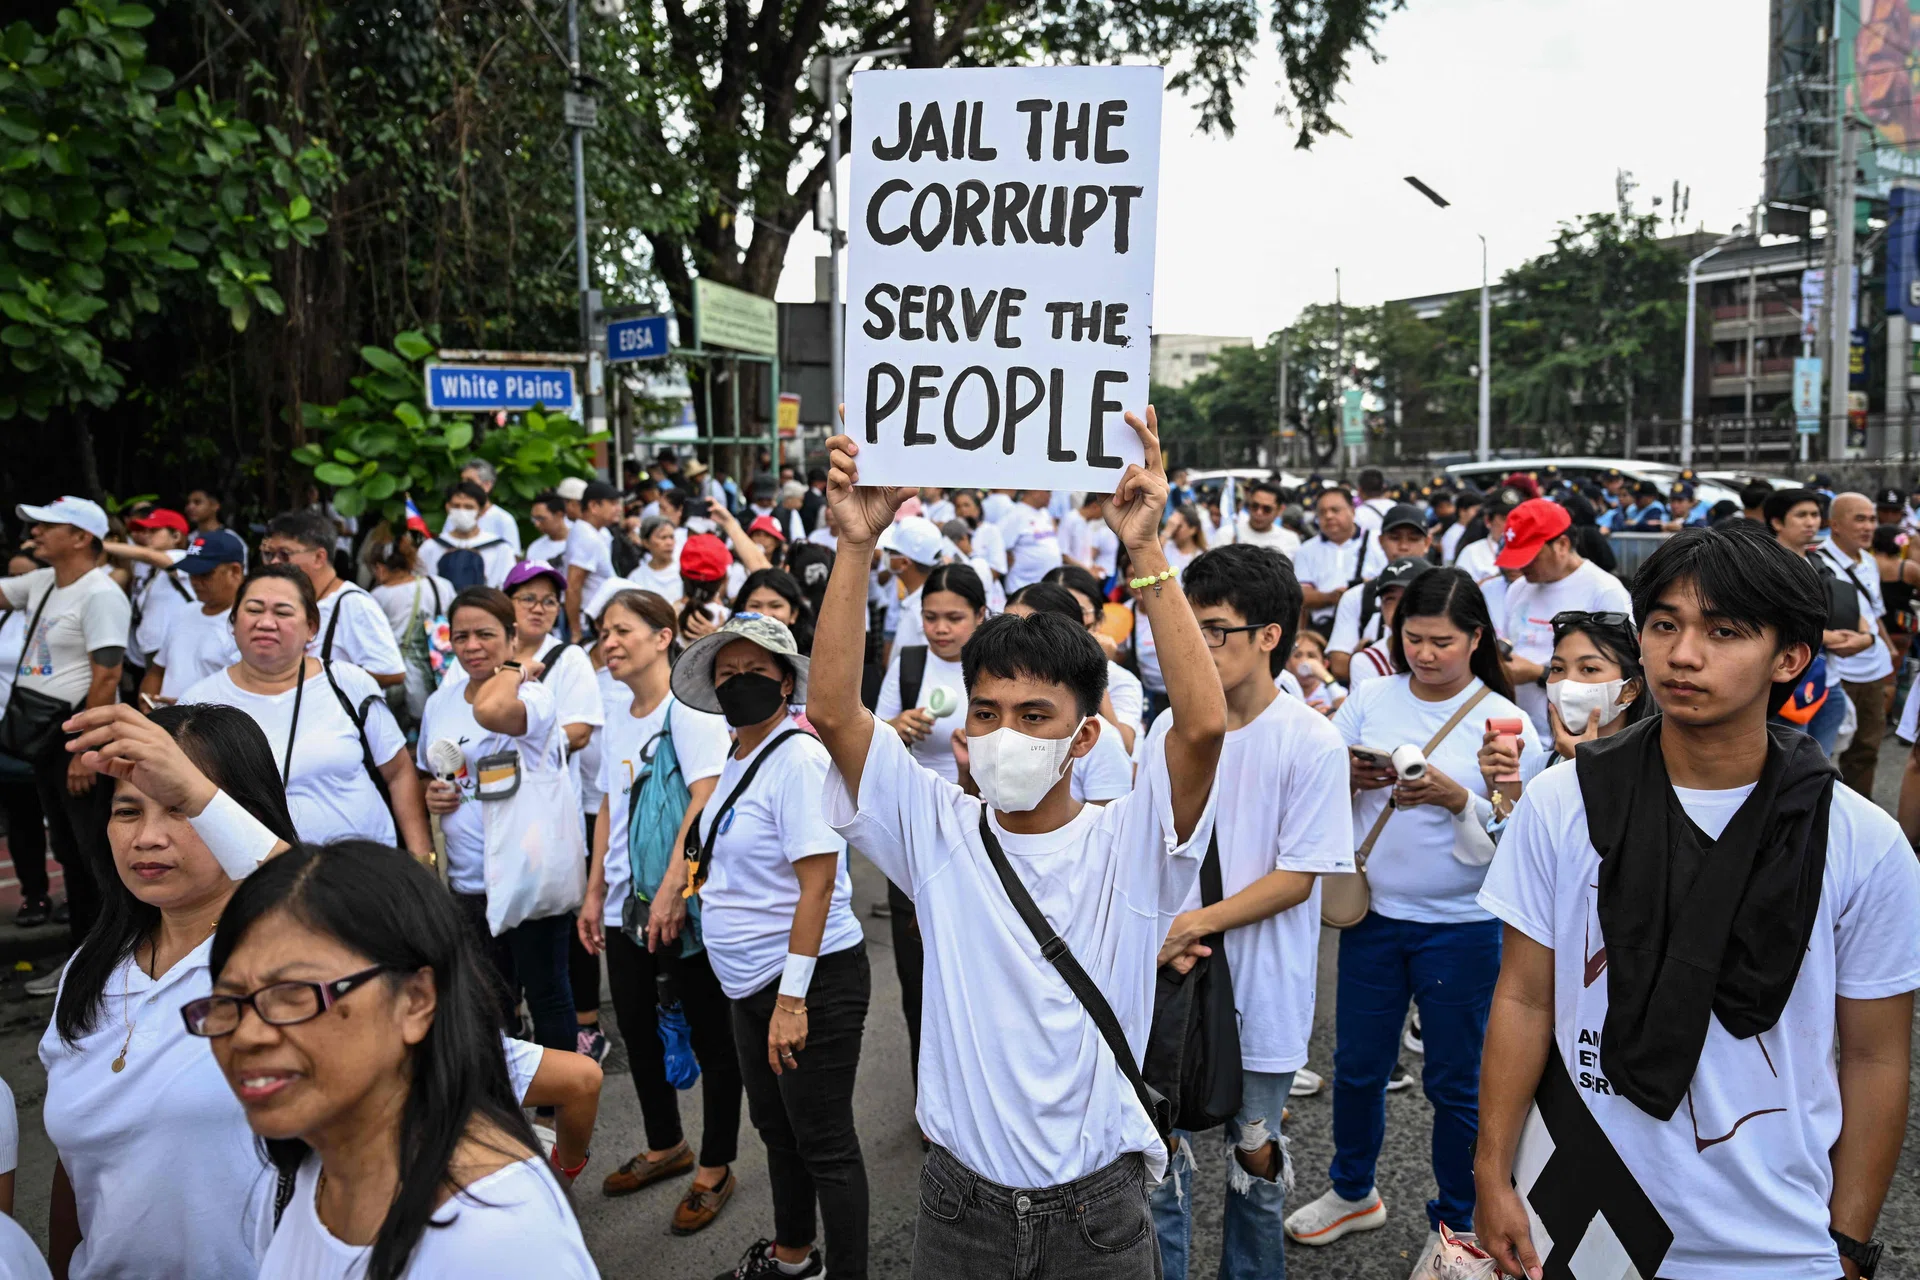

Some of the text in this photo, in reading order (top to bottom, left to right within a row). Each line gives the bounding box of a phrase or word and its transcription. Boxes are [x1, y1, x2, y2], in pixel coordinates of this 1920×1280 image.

[872, 99, 1129, 164] JAIL THE
[866, 179, 1144, 254] CORRUPT
[619, 327, 654, 351] EDSA
[863, 283, 1129, 348] SERVE THE
[441, 375, 563, 399] White Plains
[866, 362, 1129, 469] PEOPLE
[1579, 1050, 1598, 1069] ET
